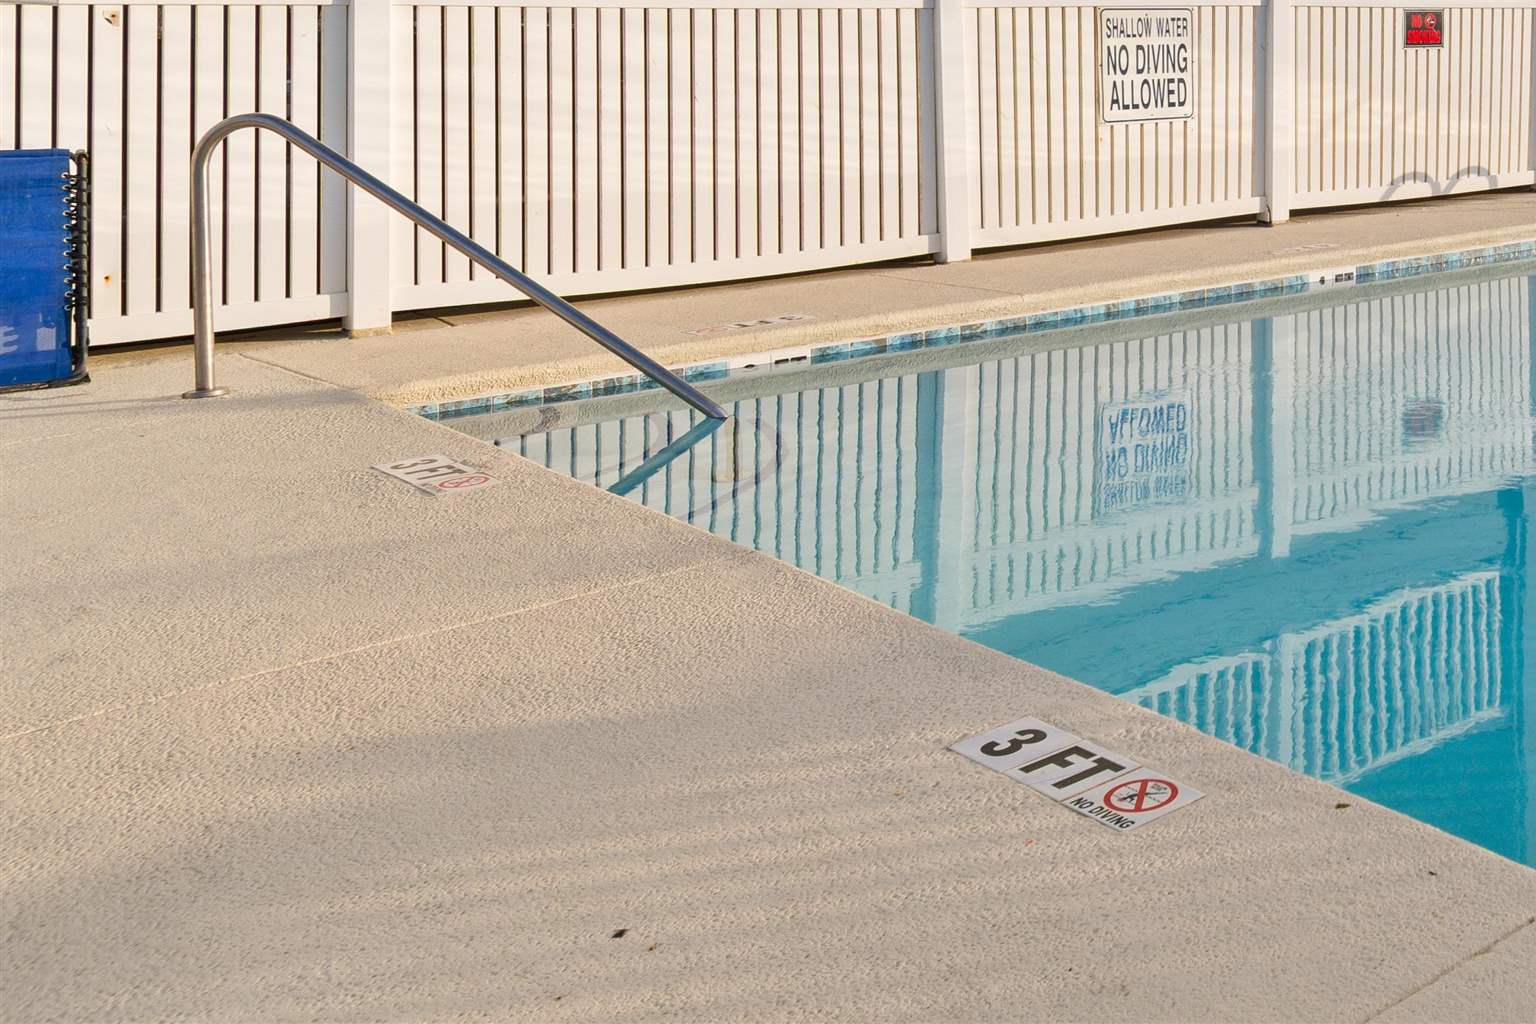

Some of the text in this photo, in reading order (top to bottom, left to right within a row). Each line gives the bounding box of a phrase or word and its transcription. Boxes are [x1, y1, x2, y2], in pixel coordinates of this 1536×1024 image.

[1106, 17, 1189, 39] SHALLOW WATER
[1106, 43, 1188, 76] NO DIVING
[1110, 77, 1187, 111] ALLOWED
[389, 458, 468, 481] 3 FT
[980, 728, 1127, 790] 3 FT
[1070, 796, 1135, 830] NO DIVING
